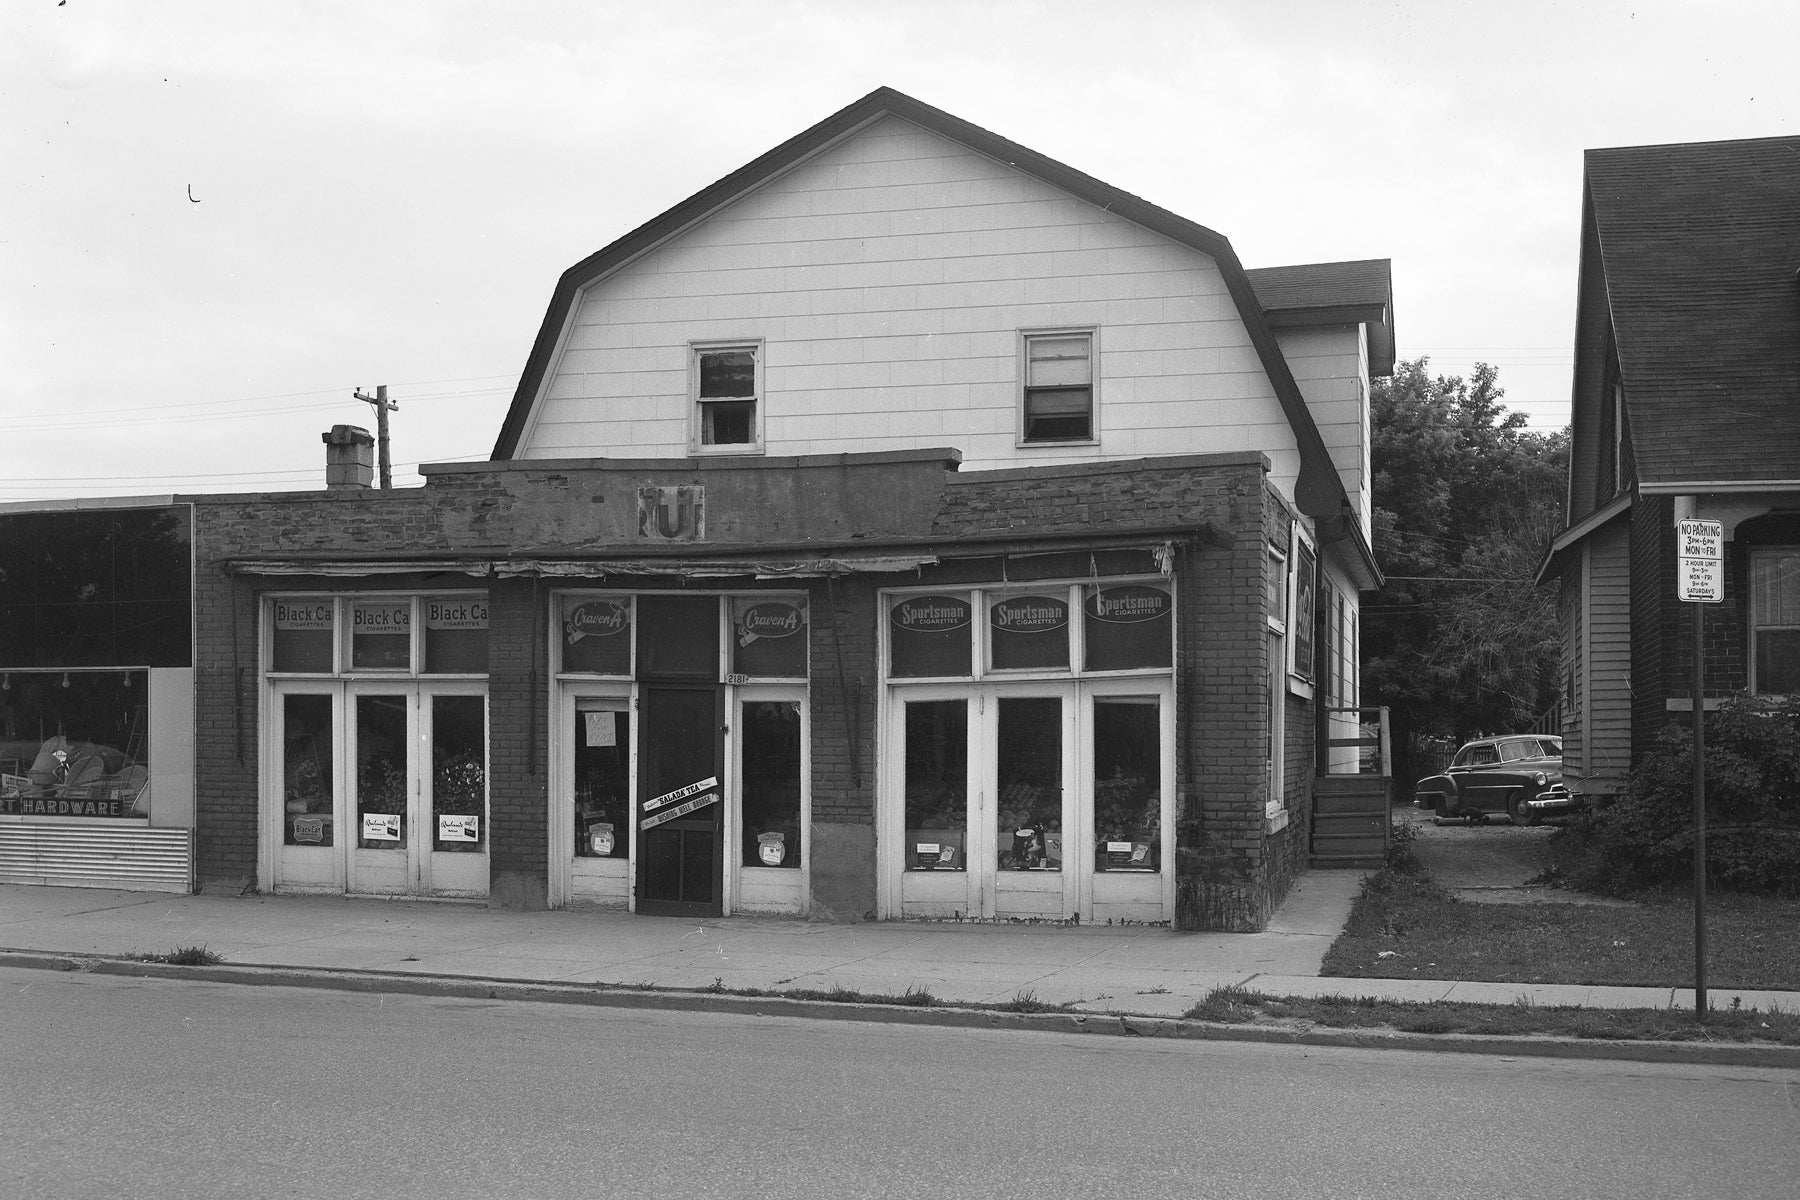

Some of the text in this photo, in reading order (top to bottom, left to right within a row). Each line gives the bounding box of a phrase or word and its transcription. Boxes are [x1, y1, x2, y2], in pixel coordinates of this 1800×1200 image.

[1682, 524, 1720, 537] NO PARKING
[1686, 546, 1700, 555] MON
[1706, 547, 1716, 556] FRI
[278, 606, 333, 621] Black Ca
[354, 610, 410, 625] Black Ca
[431, 605, 488, 620] Black Ca
[574, 608, 610, 627] Craven
[746, 609, 784, 628] Craven
[902, 604, 964, 625] Sportsman
[998, 604, 1062, 626] Sportsman
[728, 675, 745, 683] 2181
[686, 784, 700, 794] TEA
[23, 800, 120, 815] HARDWARE
